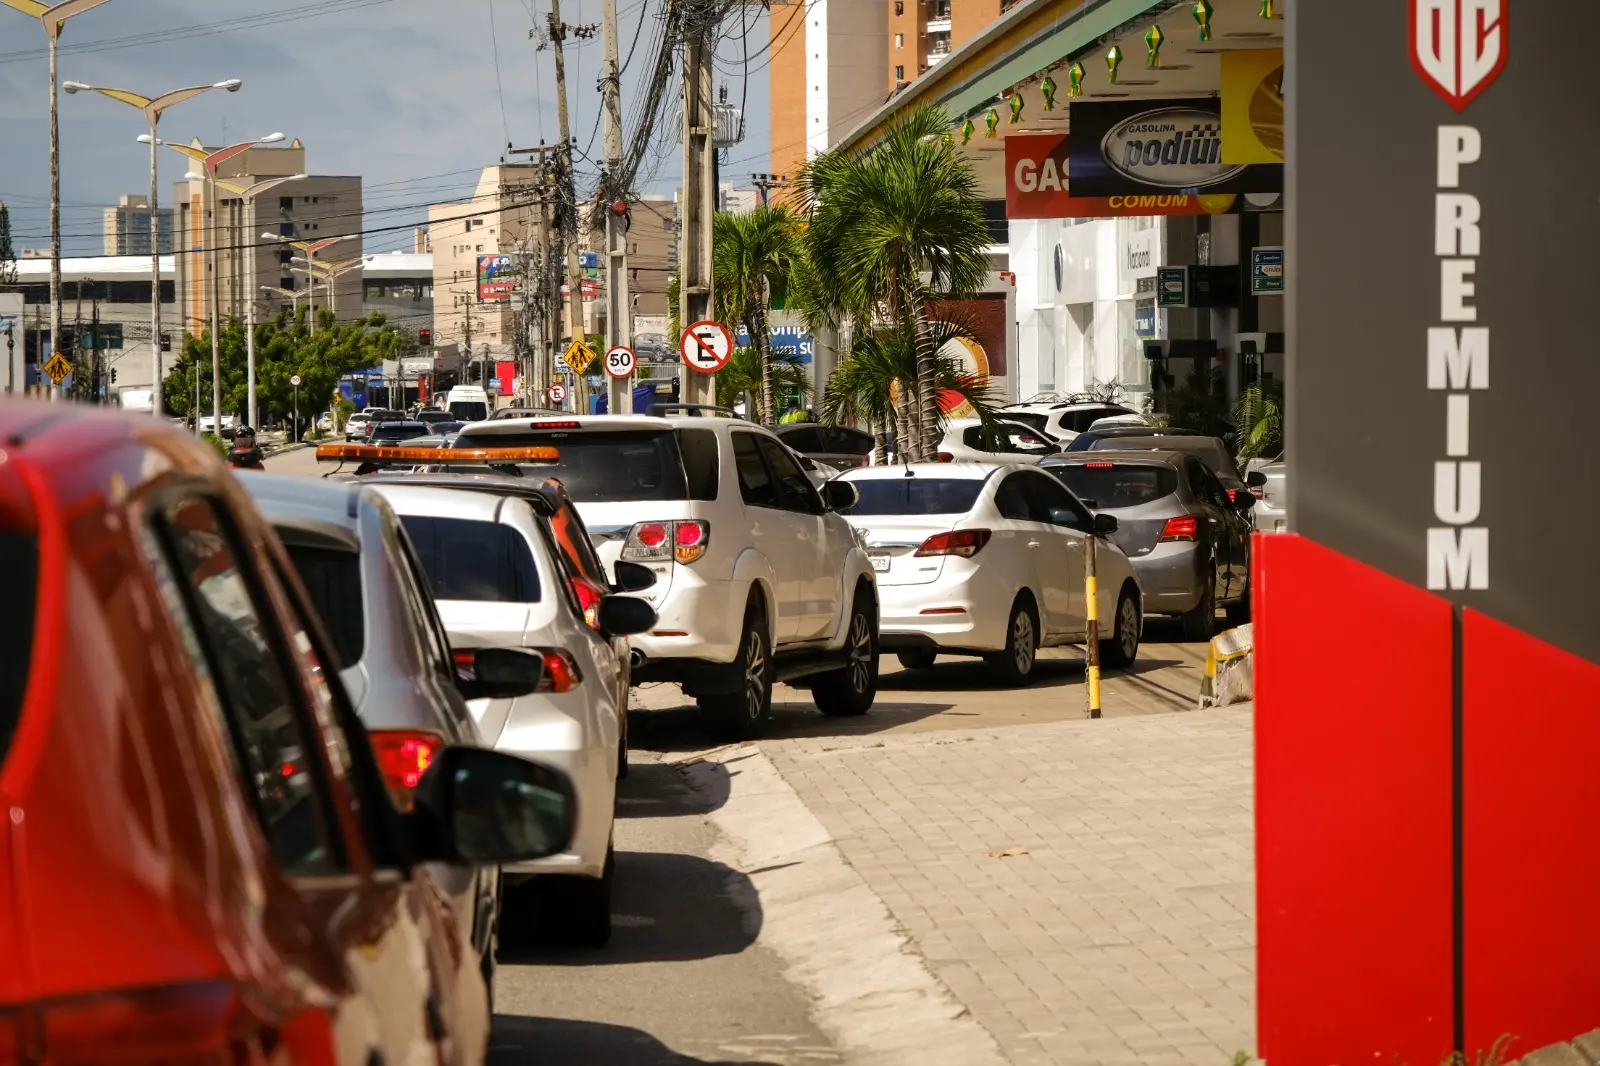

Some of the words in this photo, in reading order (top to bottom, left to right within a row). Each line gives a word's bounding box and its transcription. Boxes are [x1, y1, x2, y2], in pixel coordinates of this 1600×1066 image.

[1128, 124, 1176, 134] GASOLINA
[1108, 195, 1188, 209] COMUM
[1127, 239, 1151, 270] Nacional
[609, 353, 631, 367] 50
[1426, 125, 1490, 590] PREMIUM
